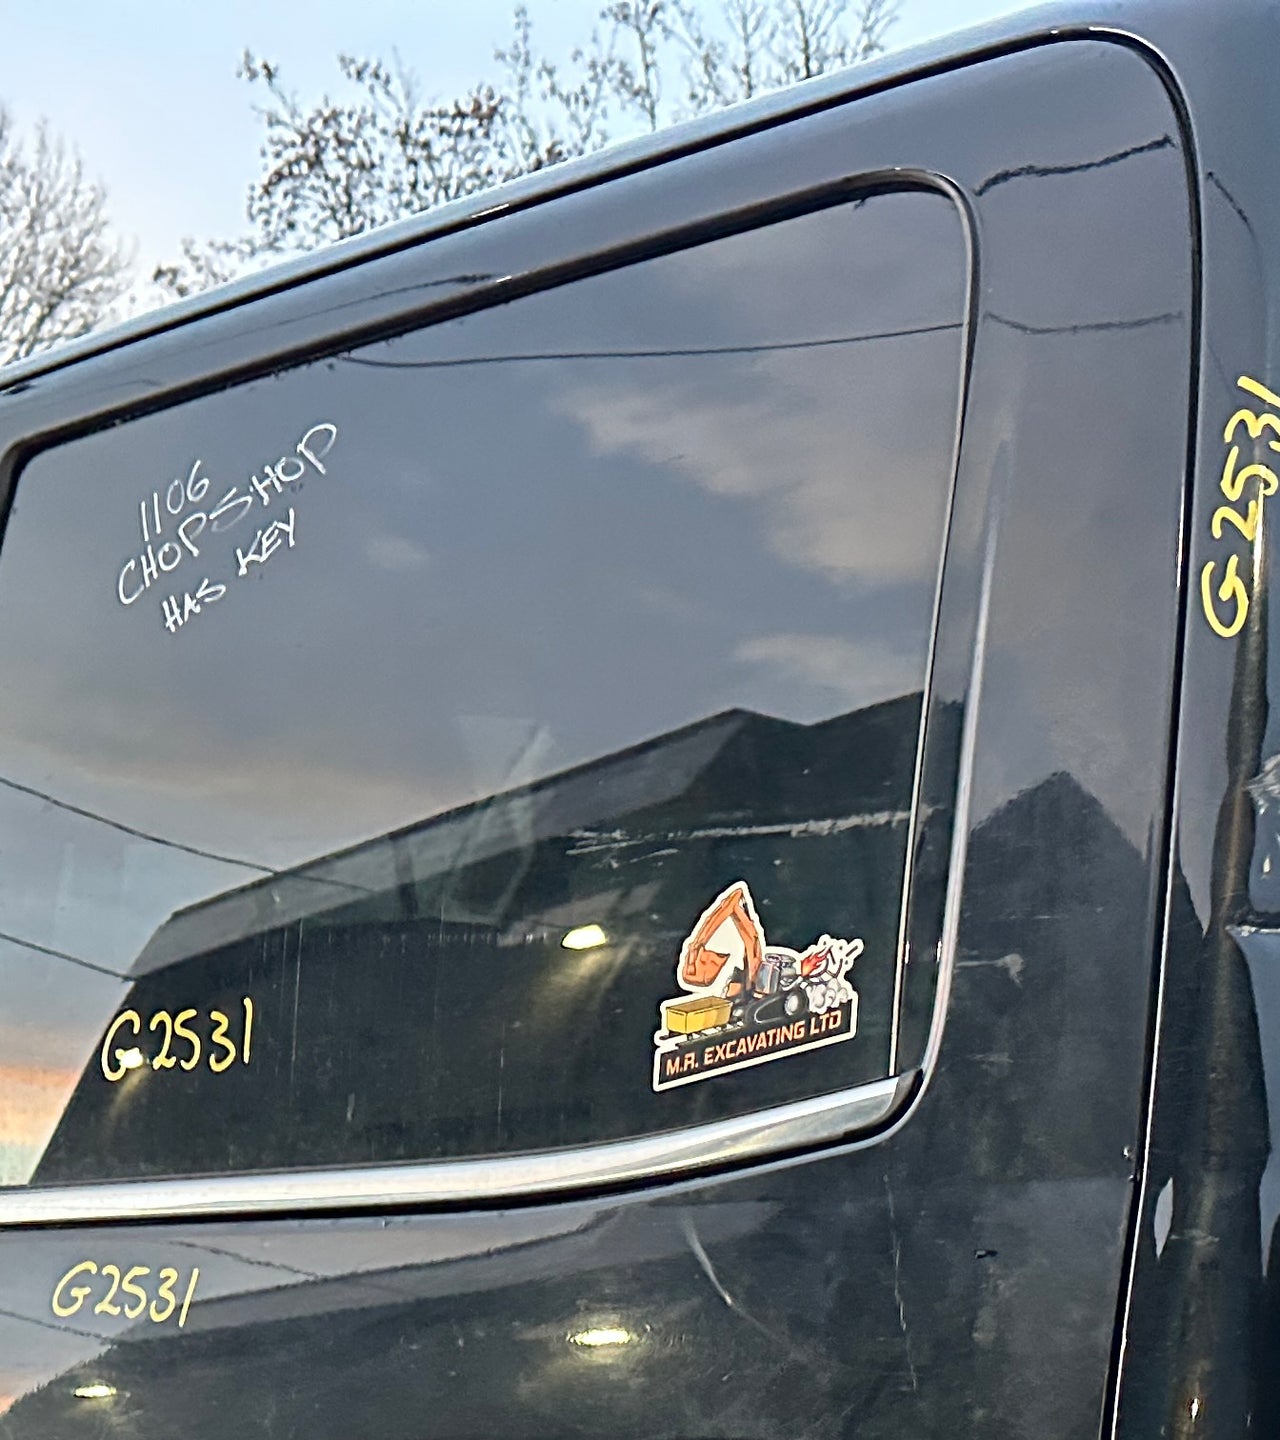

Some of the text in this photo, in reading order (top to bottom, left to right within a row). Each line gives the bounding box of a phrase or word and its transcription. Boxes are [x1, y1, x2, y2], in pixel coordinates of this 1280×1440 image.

[140, 459, 210, 542] 1106
[162, 507, 296, 633] HAS KEY
[101, 997, 253, 1082] G2531
[703, 1020, 806, 1066] EXCAVATING
[809, 1010, 843, 1036] LTD
[51, 1260, 200, 1328] G2531
